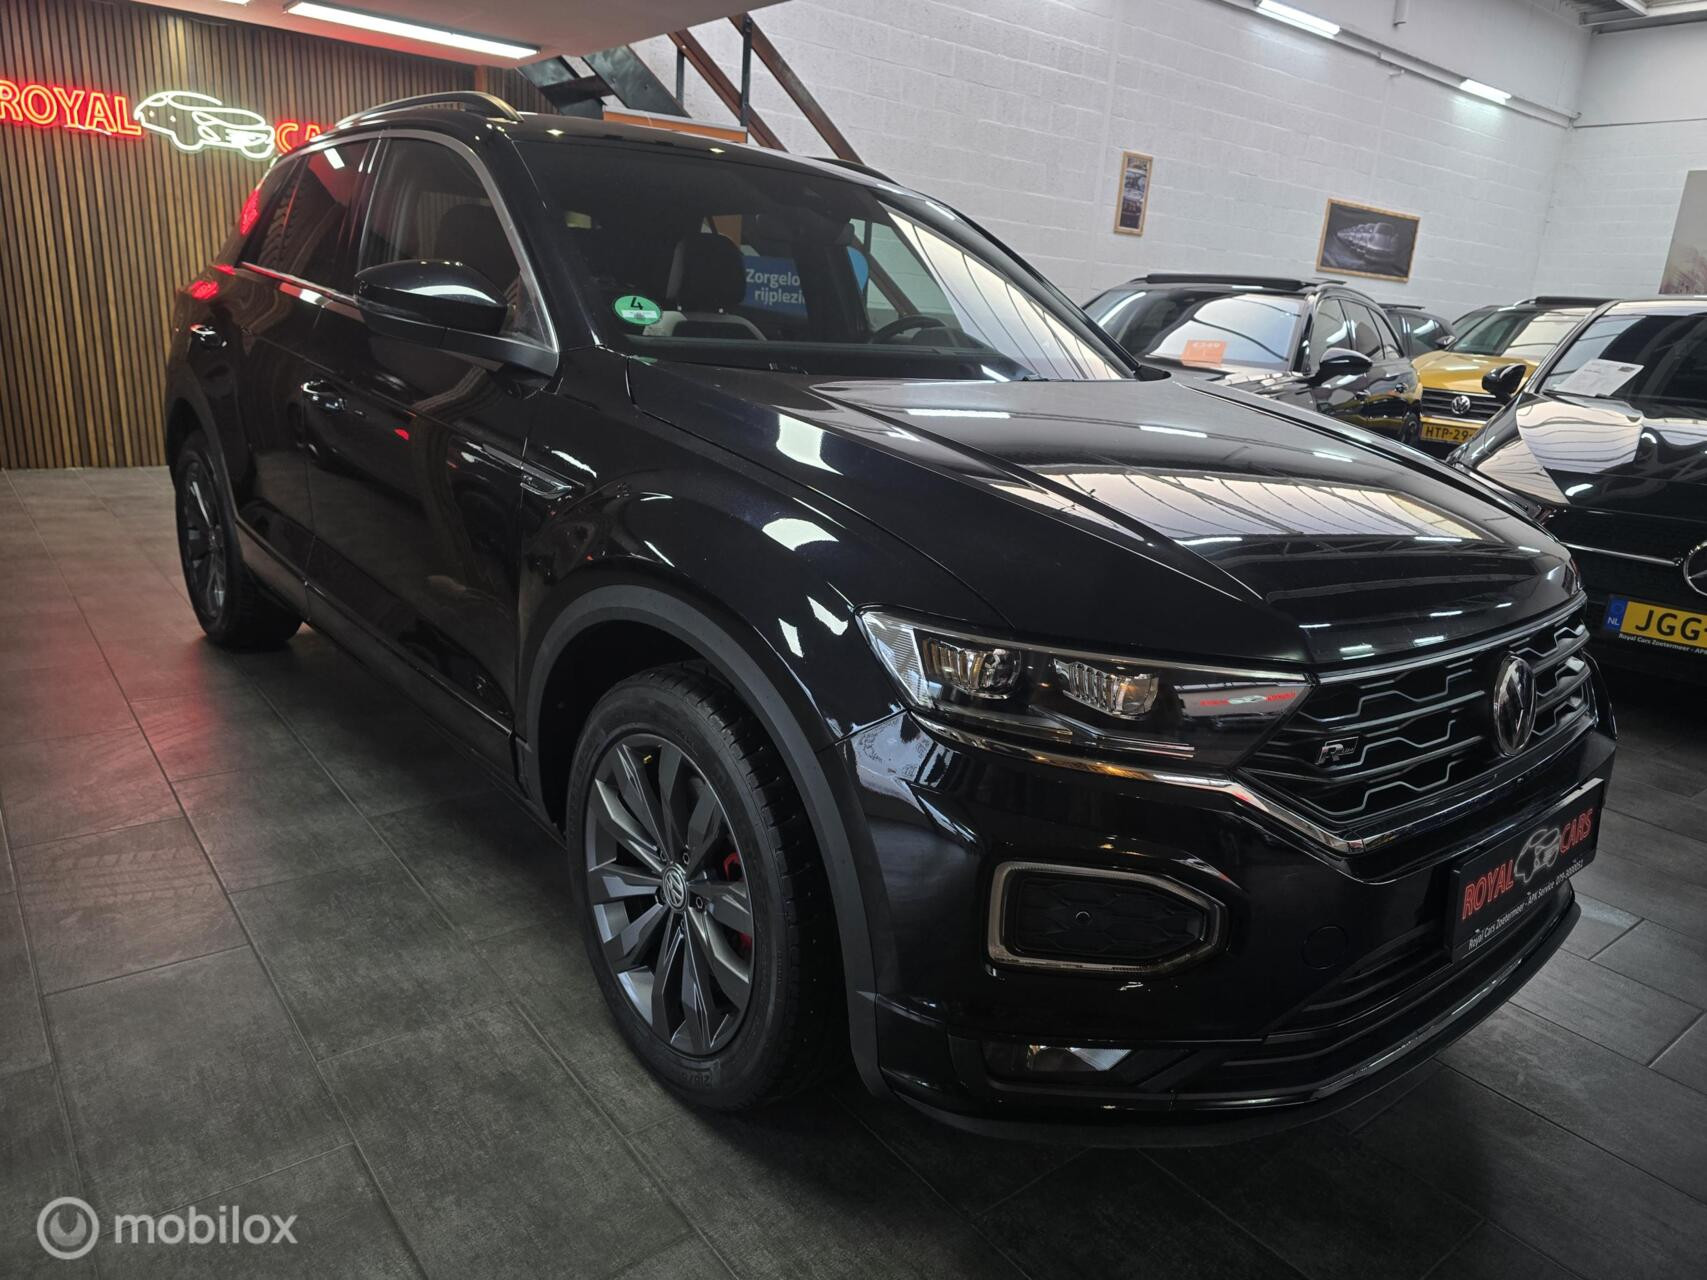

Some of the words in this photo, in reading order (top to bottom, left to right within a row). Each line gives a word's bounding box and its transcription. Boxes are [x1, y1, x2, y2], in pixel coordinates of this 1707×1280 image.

[0, 79, 142, 136] ROYAL
[745, 268, 801, 289] Zorgelo
[630, 297, 644, 310] 4
[1607, 616, 1620, 626] NL
[1635, 609, 1707, 642] JGG
[1462, 859, 1514, 920] ROYAL
[1559, 808, 1593, 854] CARS
